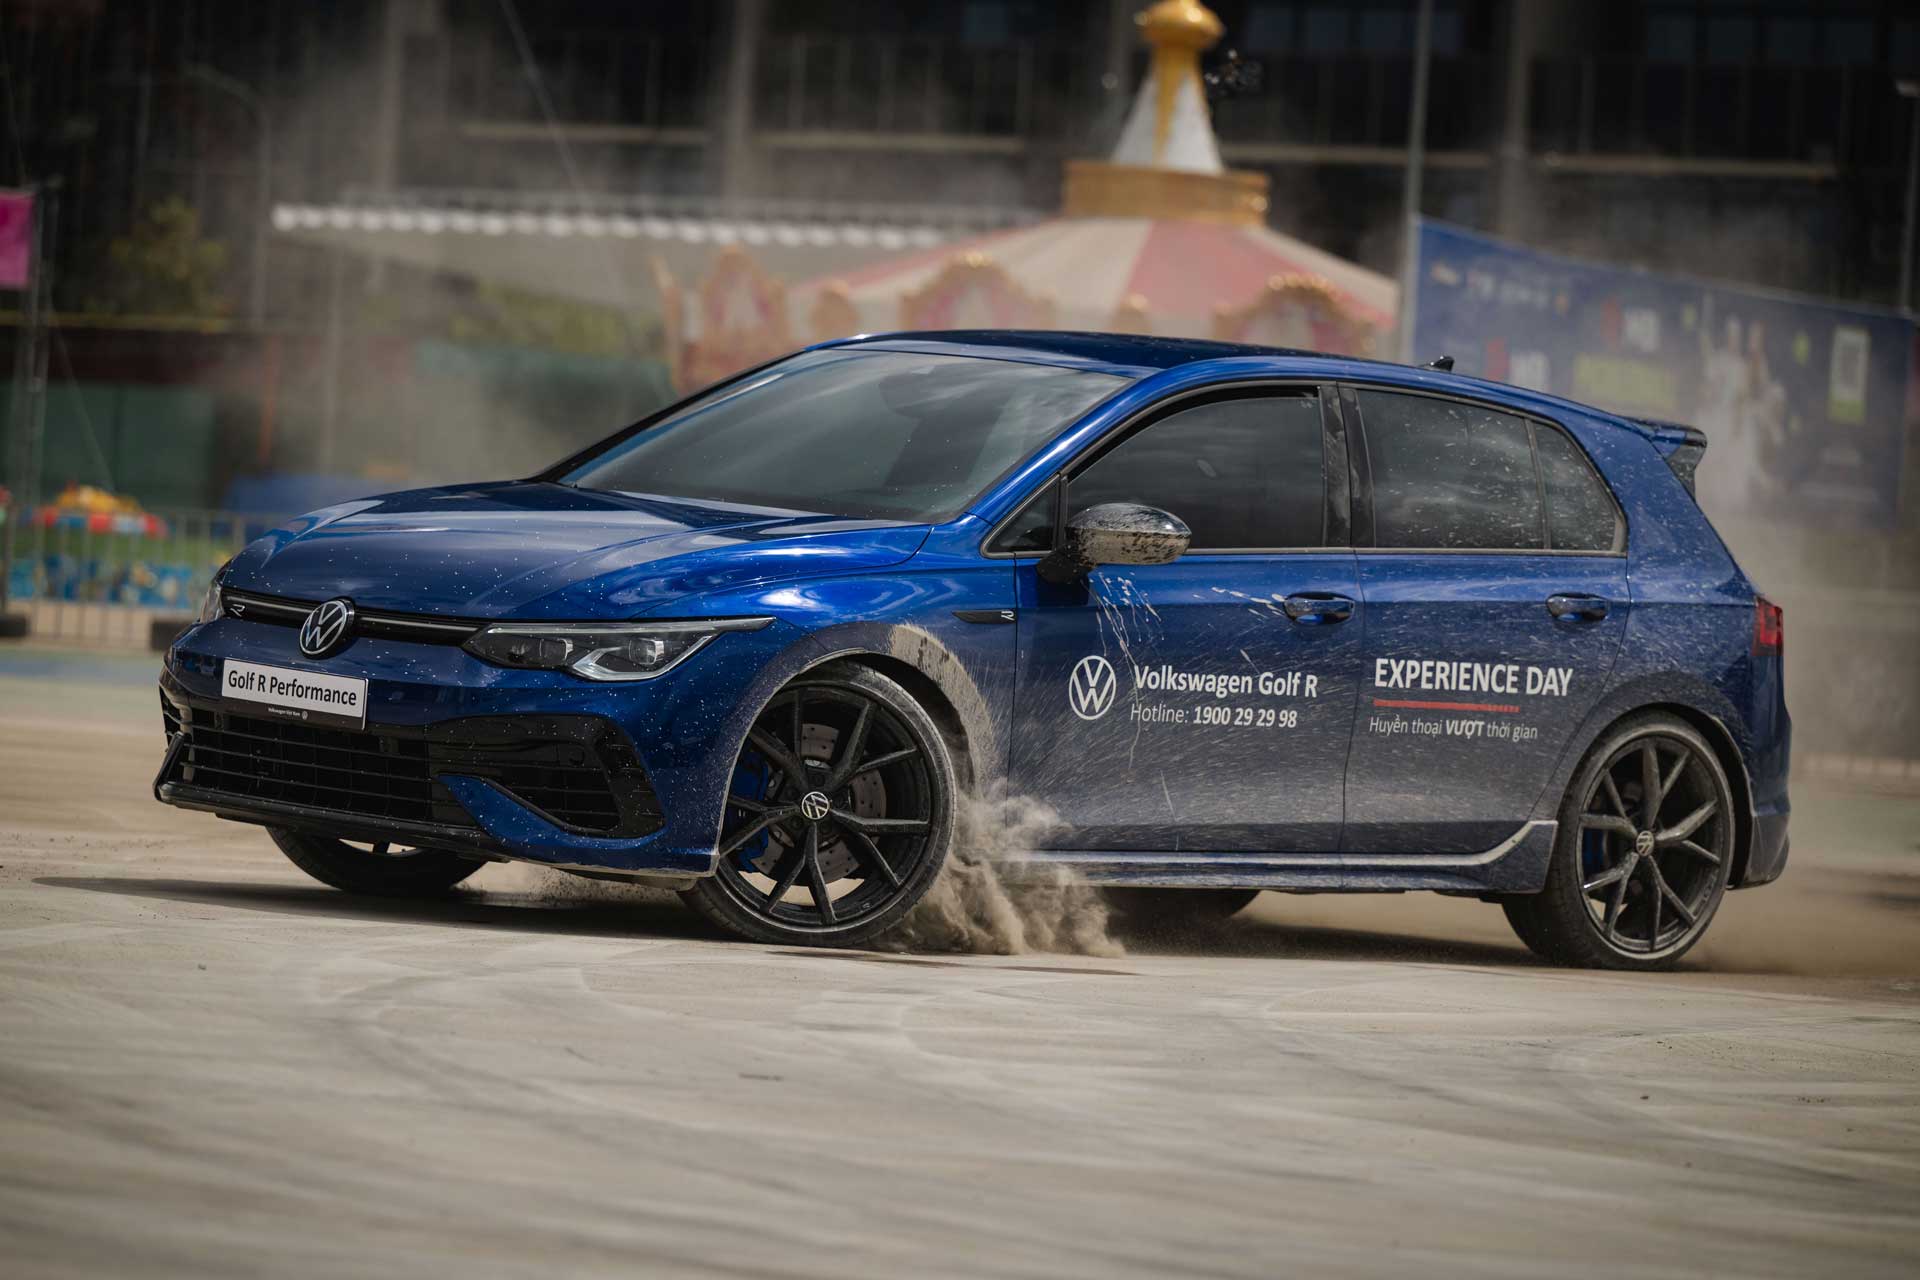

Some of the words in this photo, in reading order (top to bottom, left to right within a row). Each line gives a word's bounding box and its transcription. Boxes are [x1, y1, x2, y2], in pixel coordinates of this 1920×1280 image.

[1001, 610, 1015, 621] R
[228, 670, 255, 690] Golf
[257, 674, 266, 693] R
[269, 677, 357, 706] Performance
[1134, 665, 1252, 698] Volkswagen
[1258, 671, 1301, 697] Golf
[1305, 675, 1318, 698] R
[1375, 658, 1520, 694] EXPERIENCE
[1526, 666, 1574, 697] DAY
[1130, 703, 1190, 724] Hotline:
[1193, 706, 1231, 725] 1900
[1234, 708, 1253, 726] 29
[1256, 709, 1275, 727] 29
[1279, 710, 1298, 728] 98
[1369, 714, 1408, 737] Huyền
[1412, 718, 1442, 739] thoại
[1446, 719, 1485, 739] VƯỢT
[1487, 722, 1510, 738] thời
[1512, 725, 1538, 742] gian
